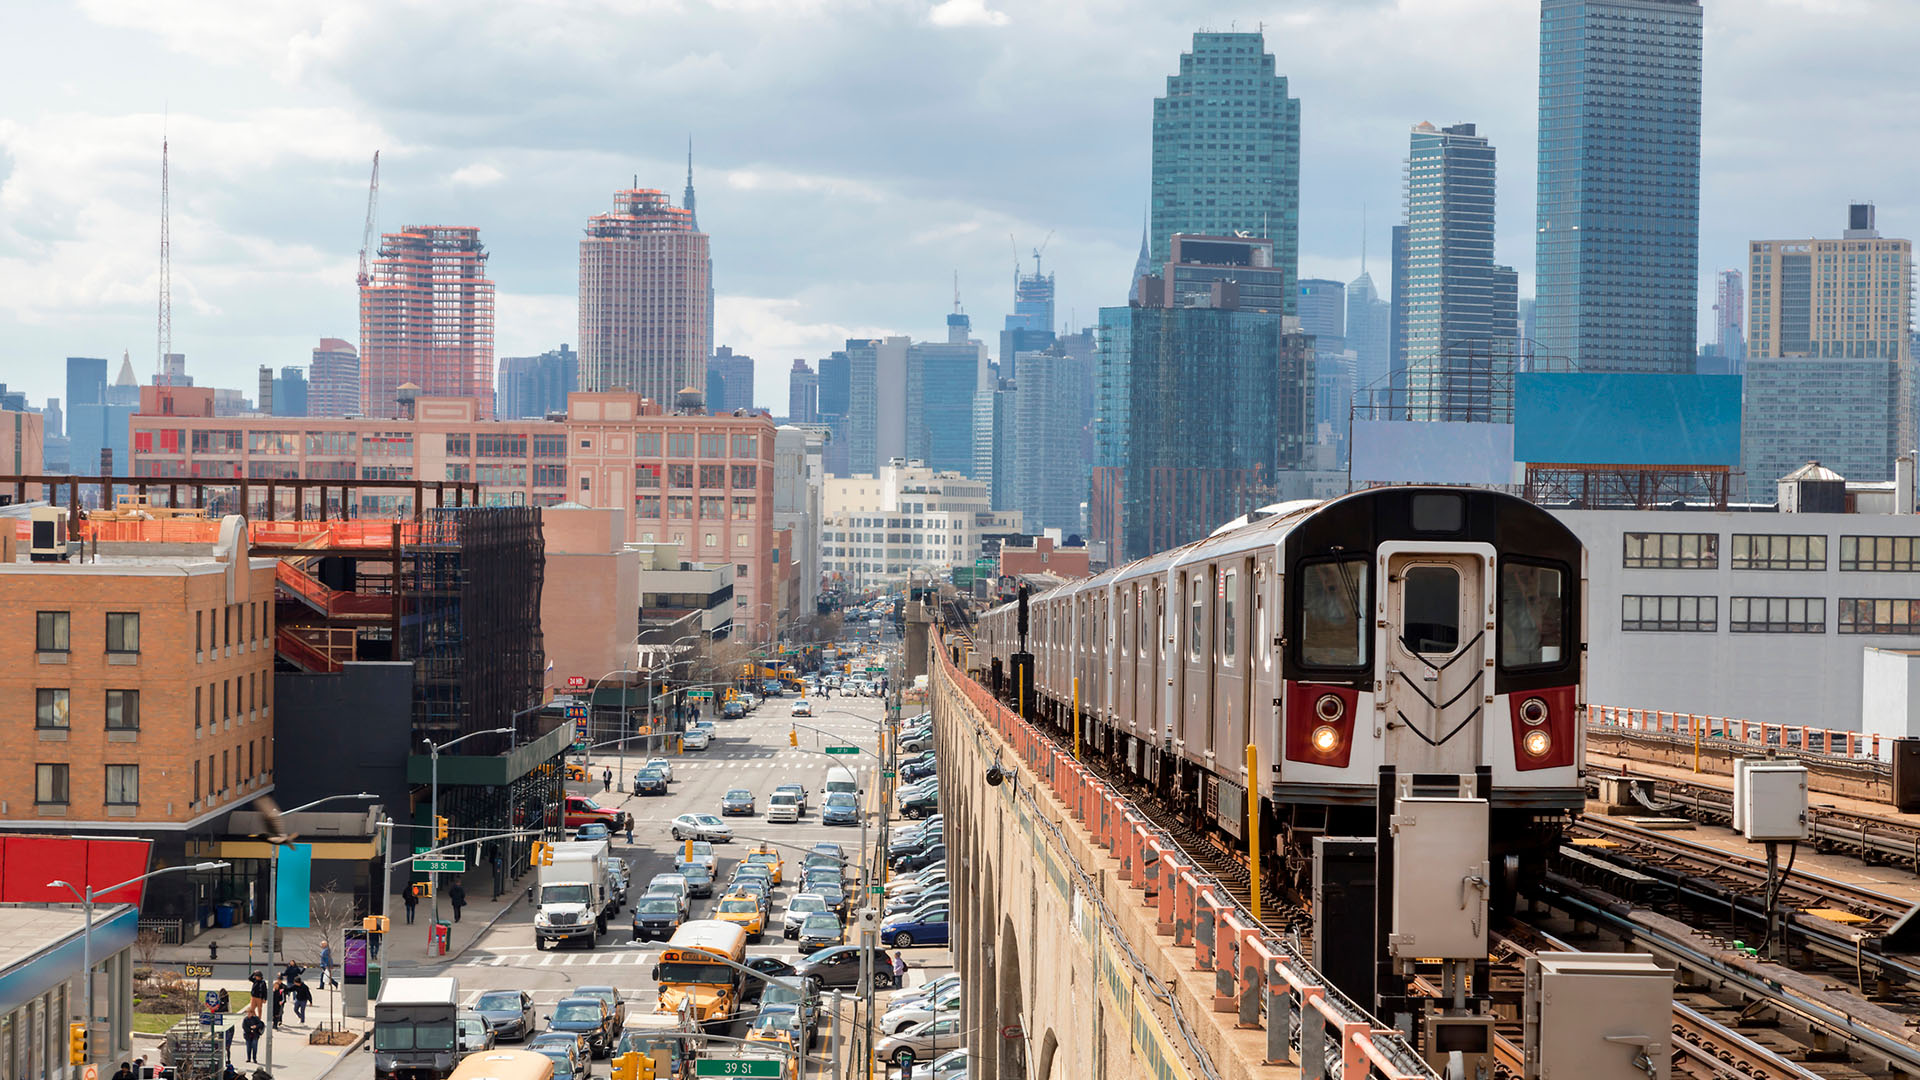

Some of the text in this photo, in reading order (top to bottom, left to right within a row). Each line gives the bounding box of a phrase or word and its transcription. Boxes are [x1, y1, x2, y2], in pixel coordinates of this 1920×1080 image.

[569, 708, 584, 716] CAR
[725, 1063, 752, 1074] 39 St
